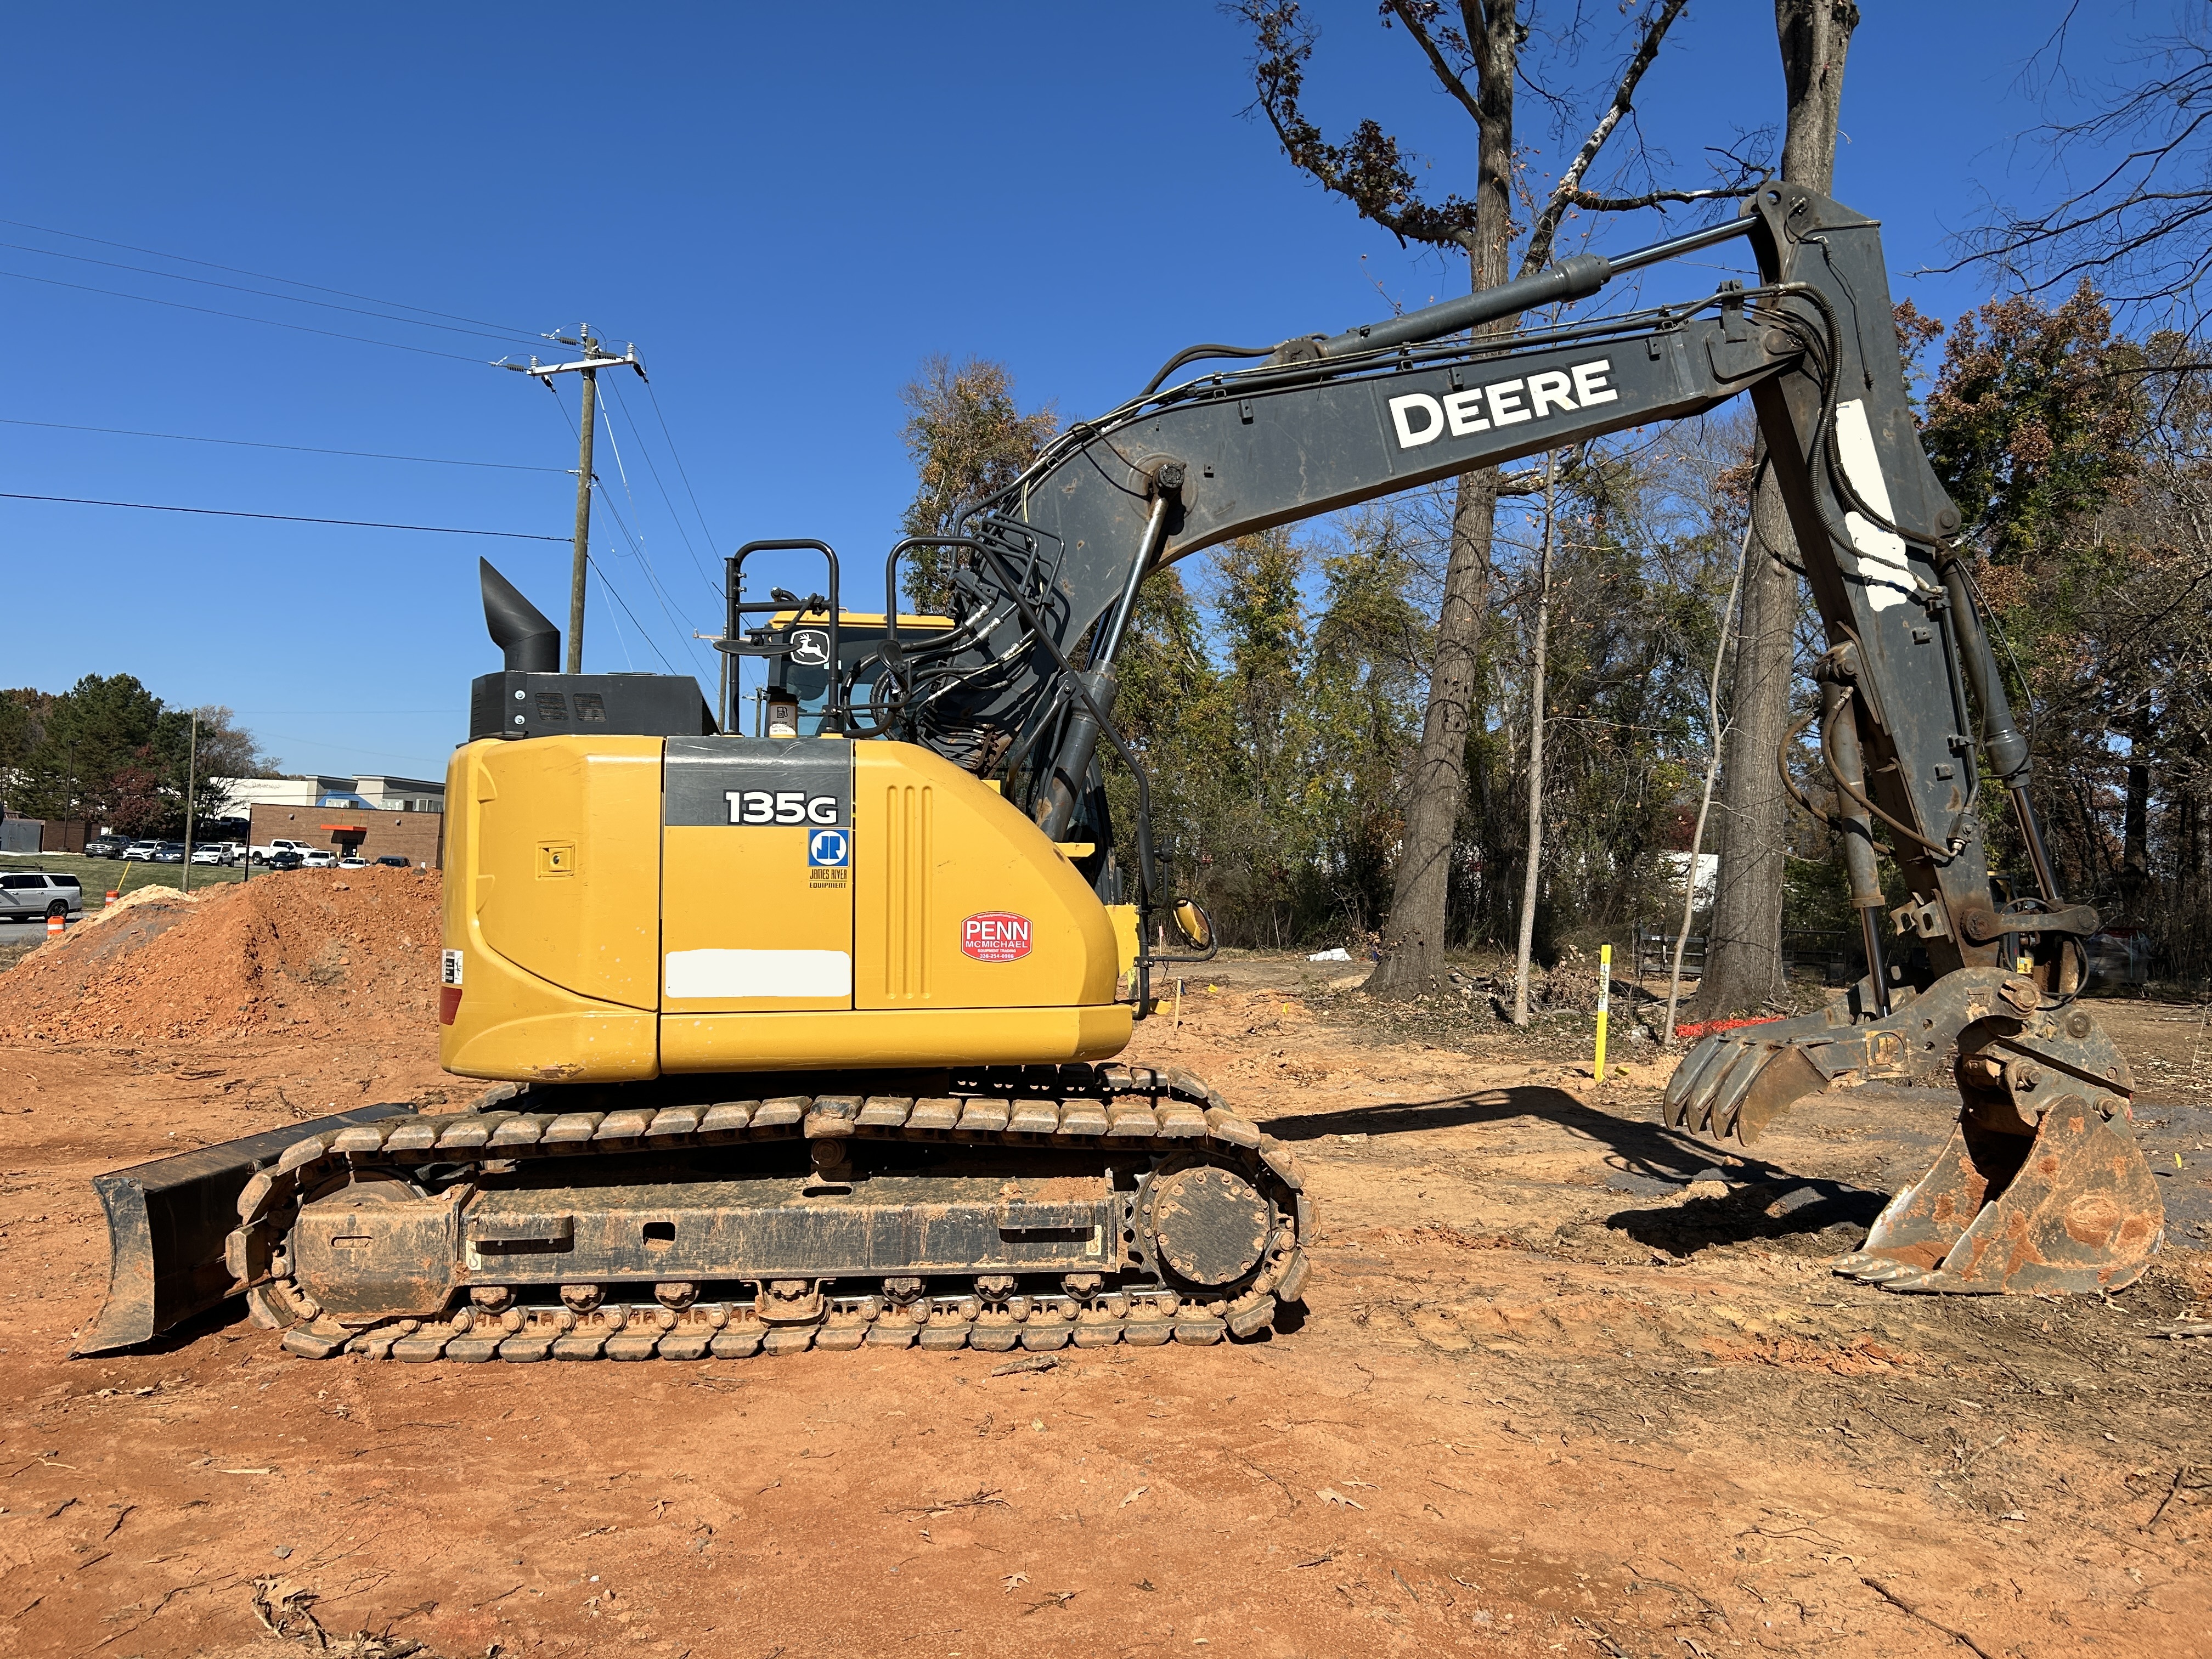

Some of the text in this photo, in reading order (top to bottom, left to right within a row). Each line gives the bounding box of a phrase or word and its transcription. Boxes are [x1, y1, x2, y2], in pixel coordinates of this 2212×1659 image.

[1389, 359, 1618, 449] DEERE
[725, 791, 838, 825] 135G
[816, 836, 840, 860] JR
[810, 868, 847, 879] JAMES RIVER
[966, 921, 1028, 940] PENN
